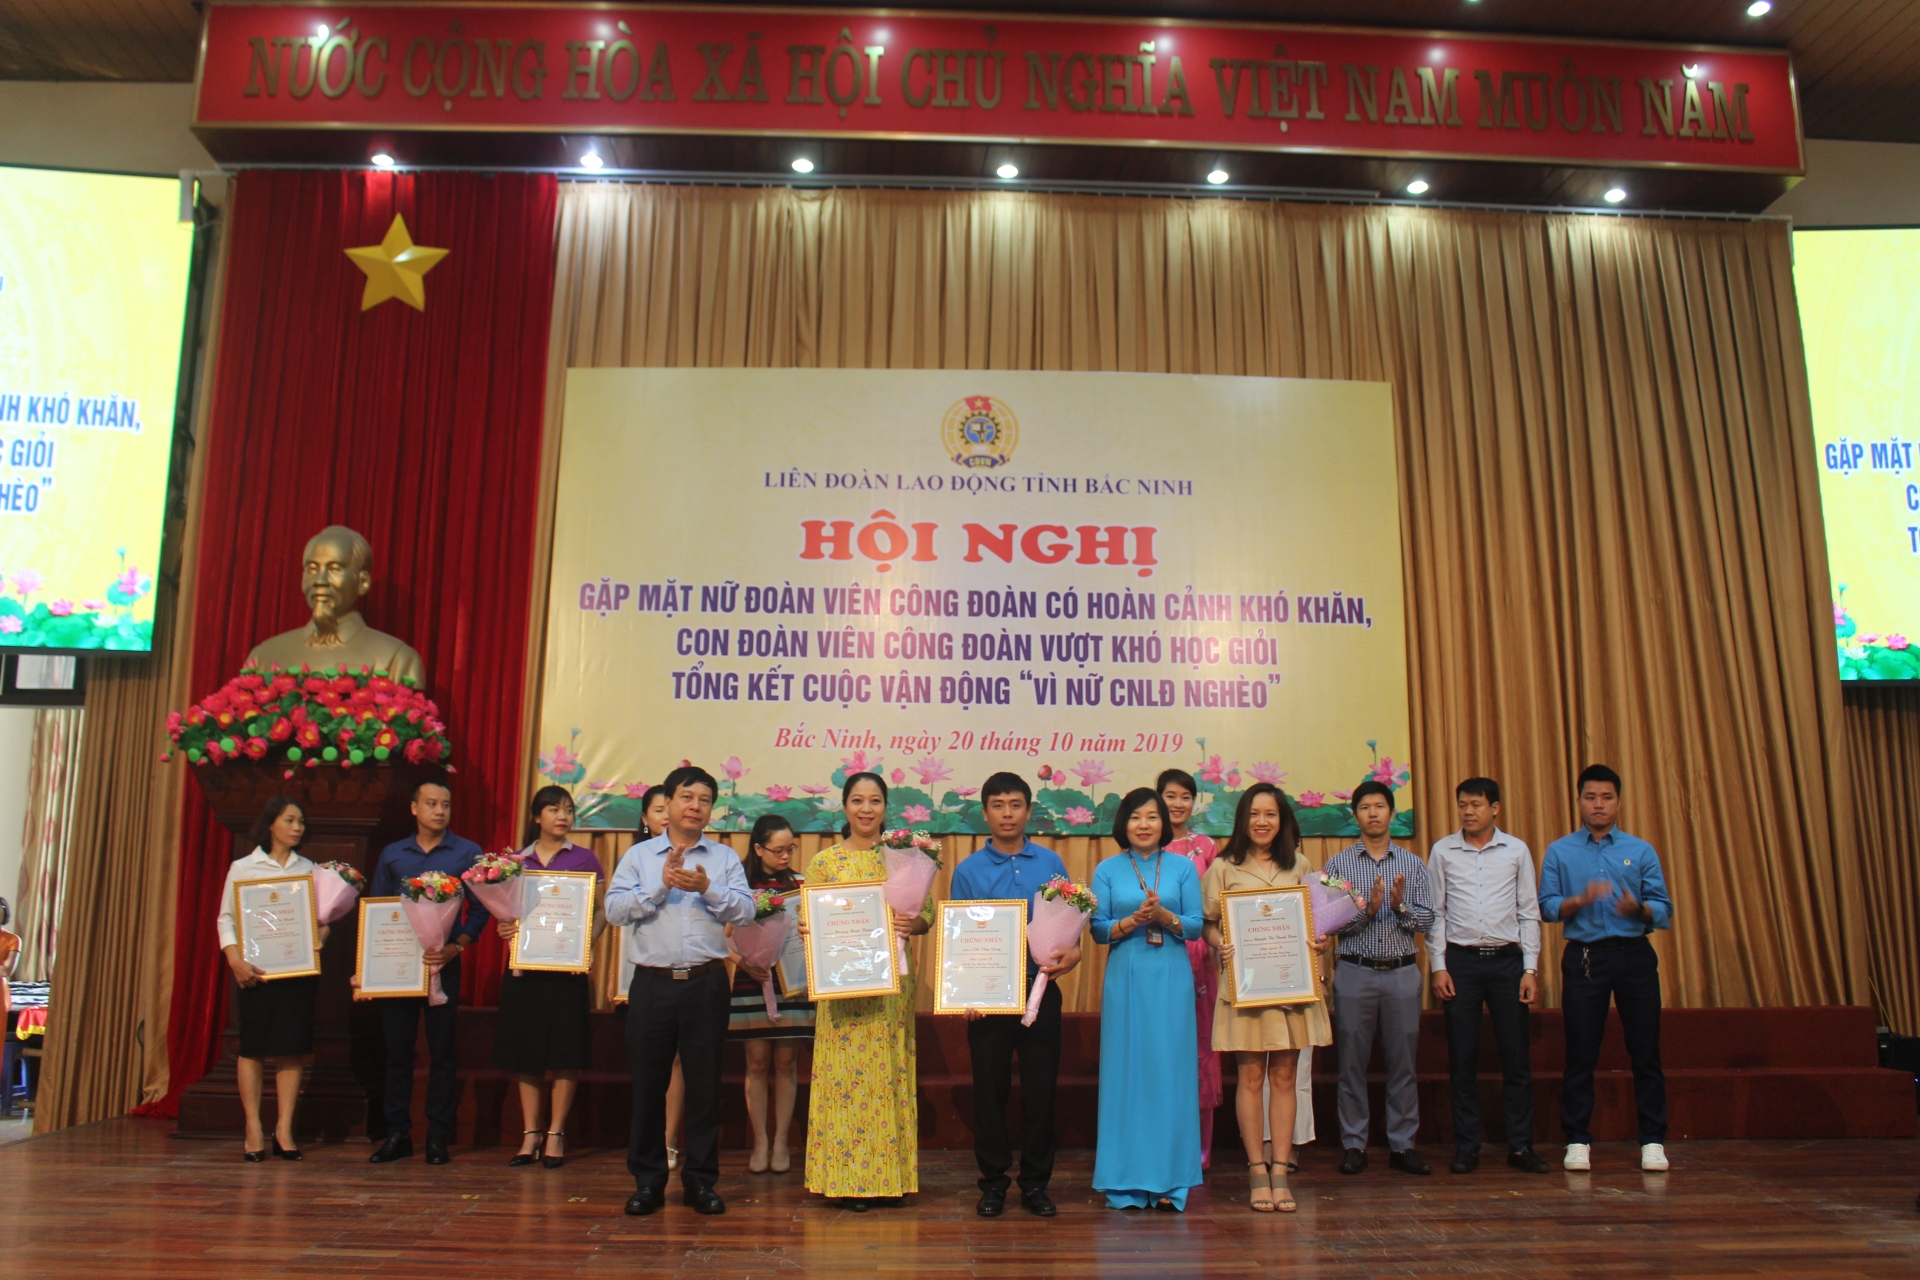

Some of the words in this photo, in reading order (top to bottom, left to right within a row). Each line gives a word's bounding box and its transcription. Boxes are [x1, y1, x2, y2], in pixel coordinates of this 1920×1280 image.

[243, 17, 388, 99] NƯỚC
[403, 21, 547, 111] CỘNG
[562, 21, 677, 102] HÒA
[692, 32, 770, 103] XÃ
[785, 28, 886, 117] HỘI
[901, 23, 1006, 110] CHỦ
[1024, 40, 1194, 117] NGHĨA
[1210, 45, 1328, 133] VIỆT
[1344, 66, 1463, 127] NAM
[1474, 56, 1623, 135] MUÔN
[1641, 63, 1755, 141] NĂM
[27, 392, 70, 424] KHÓ
[76, 394, 140, 431] KHĂN,
[10, 431, 54, 468] GIỎI
[1825, 437, 1864, 475] GẶP
[1870, 437, 1912, 475] MẶT
[764, 467, 817, 489] LIÊN
[825, 468, 889, 490] ĐOÀN
[897, 474, 943, 491] LAO
[950, 470, 1016, 496] ĐỘNG
[1022, 472, 1078, 493] TỈNH
[1085, 474, 1130, 495] BẮC
[1137, 479, 1193, 496] NINH
[799, 509, 938, 573] HỘI
[962, 523, 1158, 578] NGHỊ
[579, 577, 630, 617] GẶP
[638, 579, 693, 618] MẶT
[701, 581, 739, 614] NỮ
[744, 581, 814, 614] ĐOÀN
[823, 582, 881, 616] VIÊN
[889, 584, 958, 617] CÔNG
[968, 586, 1036, 618] ĐOÀN
[1046, 586, 1078, 619] CÓ
[1087, 587, 1155, 620] HOÀN
[1164, 585, 1232, 622] CẢNH
[1240, 590, 1289, 623] KHÓ
[1297, 591, 1372, 627] KHĂN,
[677, 628, 729, 656] CON
[737, 624, 808, 657] ĐOÀN
[816, 626, 874, 659] VIÊN
[884, 626, 953, 660] CÔNG
[962, 629, 1031, 661] ĐOÀN
[1040, 632, 1103, 668] VƯỢT
[1112, 631, 1161, 664] KHÓ
[1170, 636, 1220, 670] HỌC
[1228, 629, 1277, 665] GIỎI
[672, 661, 738, 700] TỔNG
[747, 664, 794, 702] KẾT
[803, 669, 871, 708] CUỘC
[880, 669, 931, 709] VẬN
[940, 671, 1010, 710] ĐỘNG
[1020, 670, 1057, 706] “VÌ
[1066, 673, 1103, 706] NỮ
[1110, 679, 1175, 707] CNLĐ
[1184, 674, 1281, 708] NGHÈO”
[773, 722, 815, 748] Bắc
[822, 727, 882, 752] Ninh,
[889, 732, 941, 755] ngày
[948, 730, 974, 751] 20
[980, 731, 1041, 756] tháng
[1049, 732, 1073, 752] 10
[1079, 732, 1125, 753] năm
[1132, 733, 1184, 754] 2019
